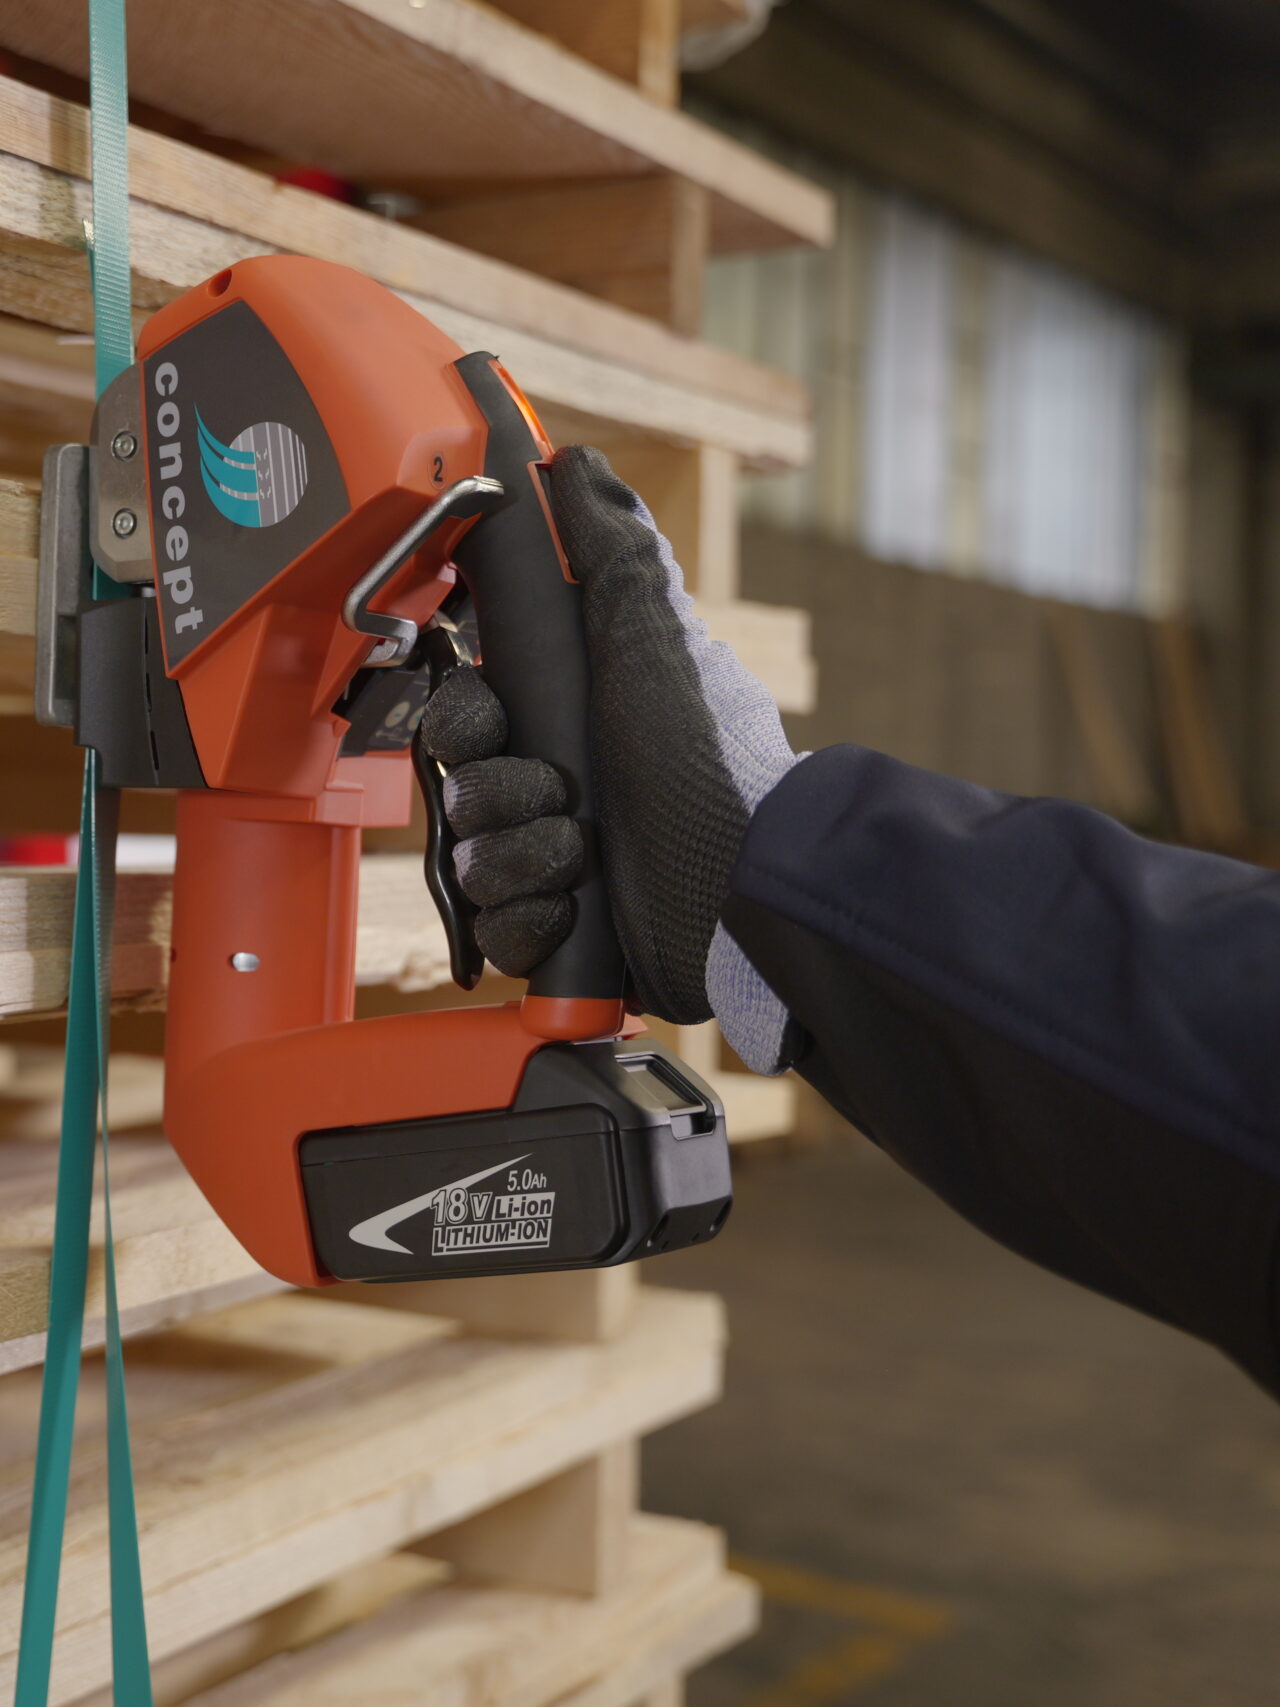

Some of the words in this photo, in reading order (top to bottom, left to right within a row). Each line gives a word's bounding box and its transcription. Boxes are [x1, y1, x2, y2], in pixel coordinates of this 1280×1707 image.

[434, 456, 444, 482] 2
[155, 362, 204, 635] concept
[507, 1168, 547, 1192] 5.0Ah
[494, 1195, 553, 1219] Li-ion
[432, 1220, 550, 1254] LITHIUM-ION
